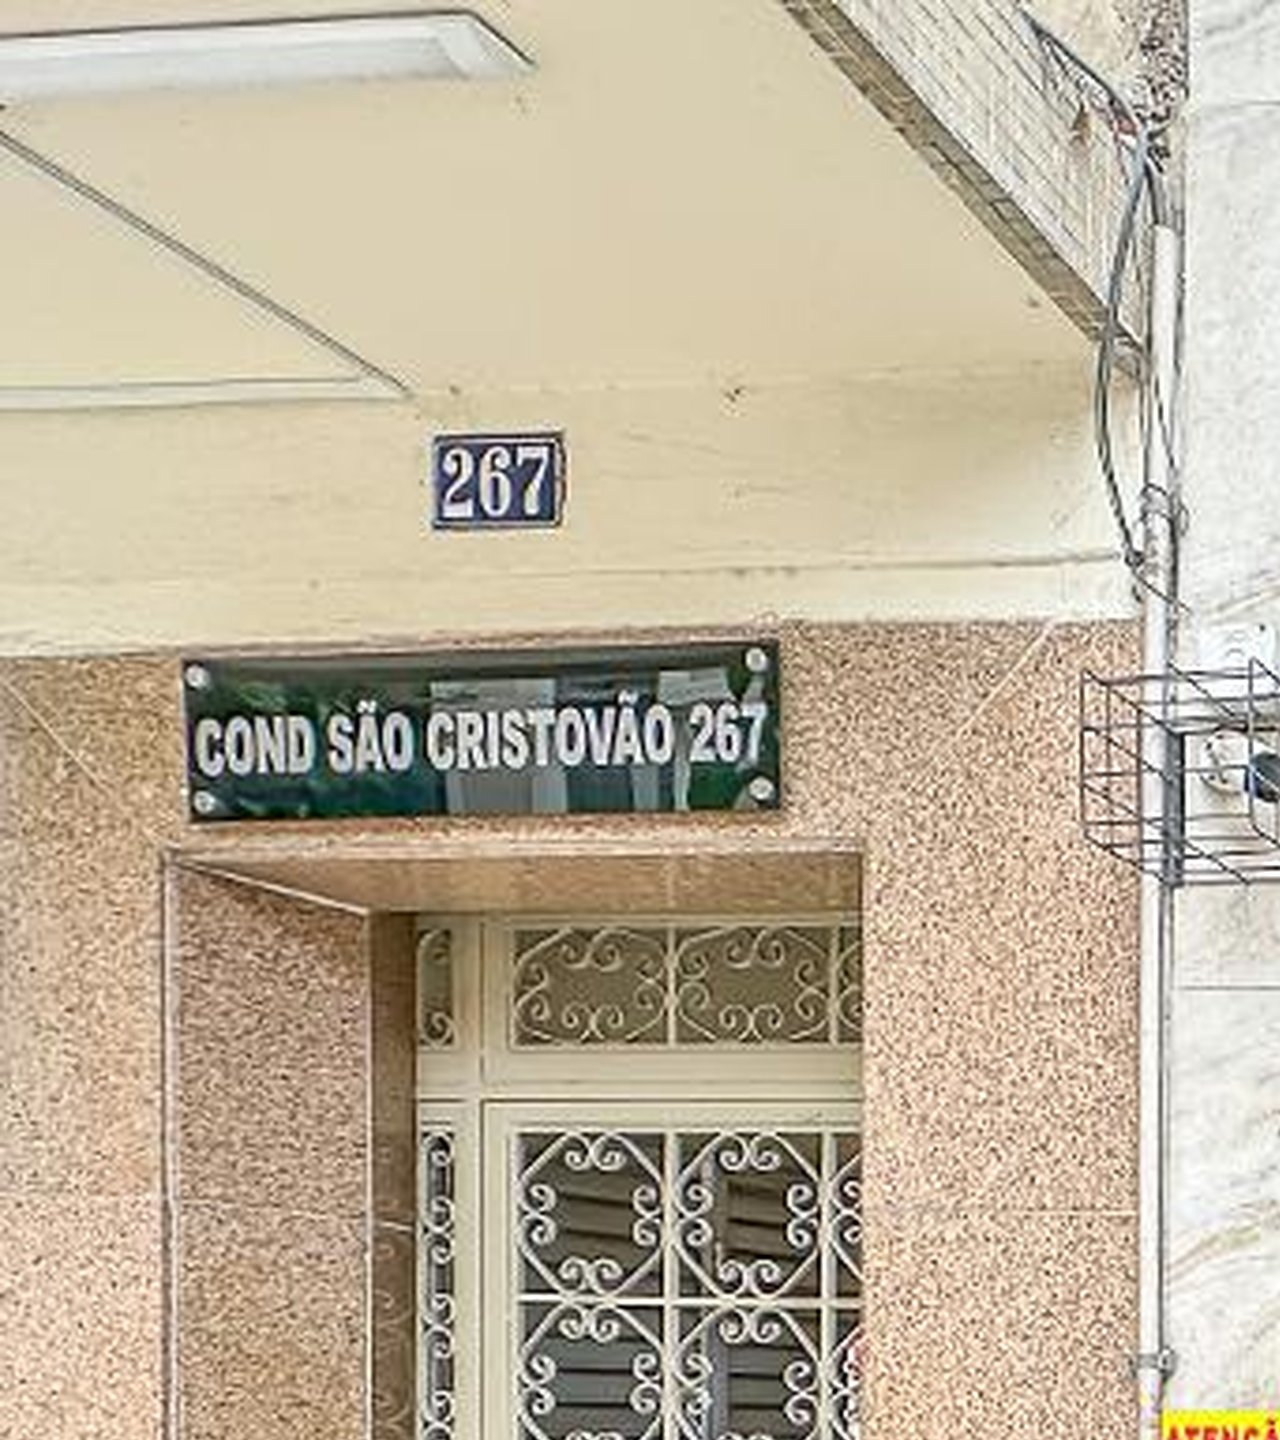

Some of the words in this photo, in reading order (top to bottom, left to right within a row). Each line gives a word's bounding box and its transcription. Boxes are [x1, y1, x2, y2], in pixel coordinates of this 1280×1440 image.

[442, 446, 549, 517] 267
[195, 715, 316, 776] COND
[328, 700, 414, 774] SÃO
[426, 689, 675, 770] CRISTOVÃO
[689, 701, 767, 764] 267
